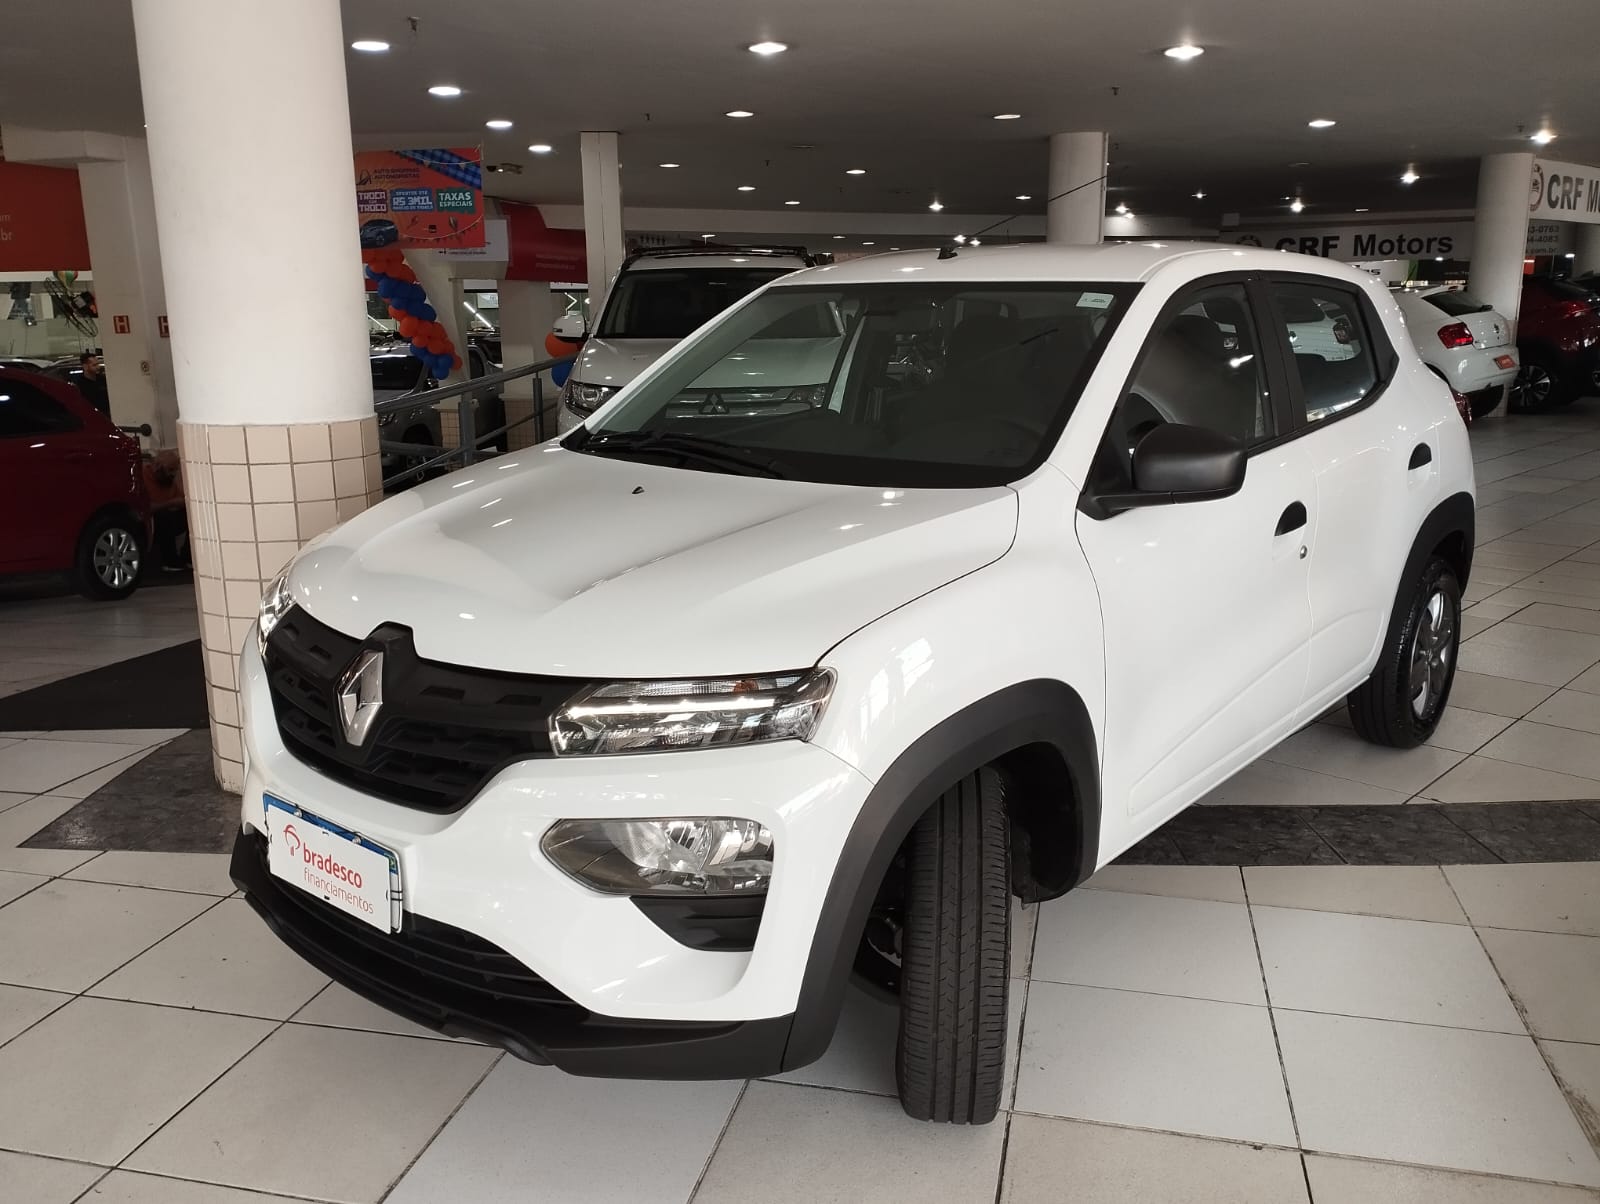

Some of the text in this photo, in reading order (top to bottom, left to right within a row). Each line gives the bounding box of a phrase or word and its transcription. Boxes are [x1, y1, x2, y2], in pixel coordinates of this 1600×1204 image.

[358, 191, 386, 200] TROCA
[438, 191, 471, 201] TAXAS
[1547, 174, 1584, 210] CRF
[359, 203, 387, 212] TROCO
[1275, 234, 1454, 257] CRF Motors
[303, 842, 362, 889] bradesco
[304, 867, 374, 914] financiamentos
